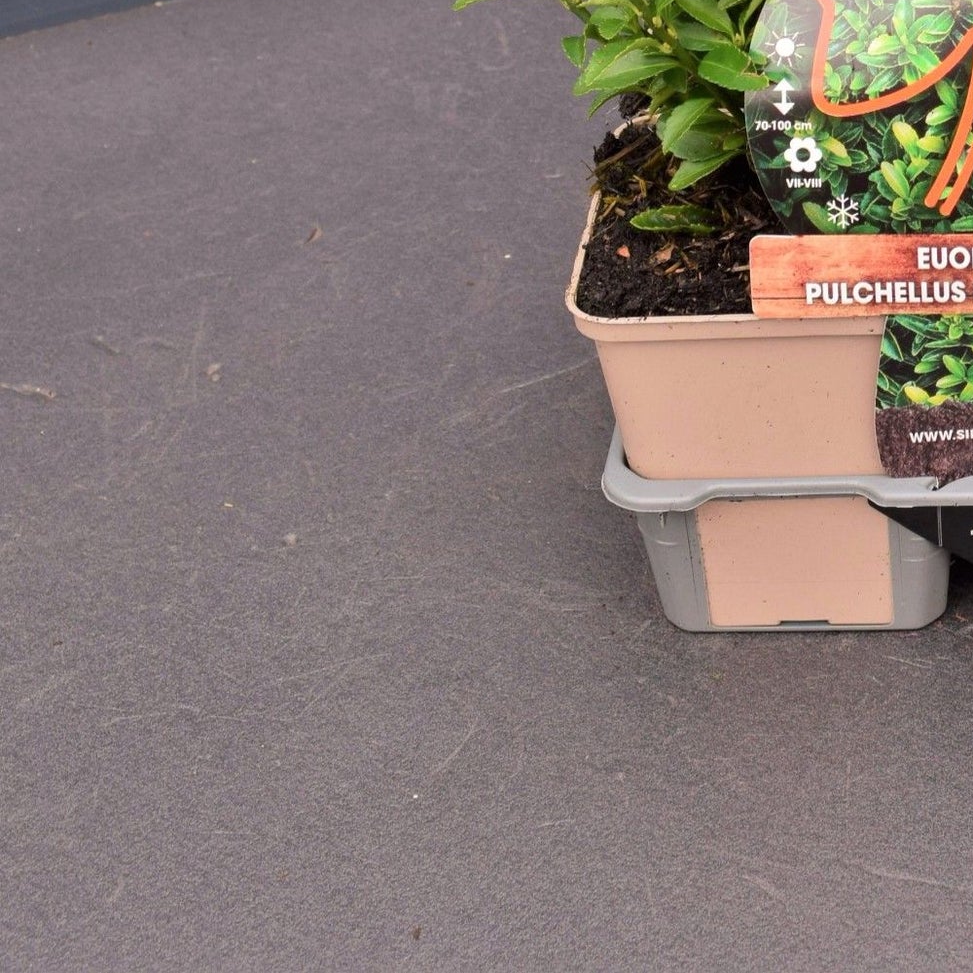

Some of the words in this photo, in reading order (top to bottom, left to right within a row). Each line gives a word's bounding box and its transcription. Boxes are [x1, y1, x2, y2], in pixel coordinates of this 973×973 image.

[754, 120, 791, 131] 70-100
[794, 121, 812, 131] cm
[786, 178, 822, 188] VII-VIII
[805, 281, 966, 304] PULCHELLUS
